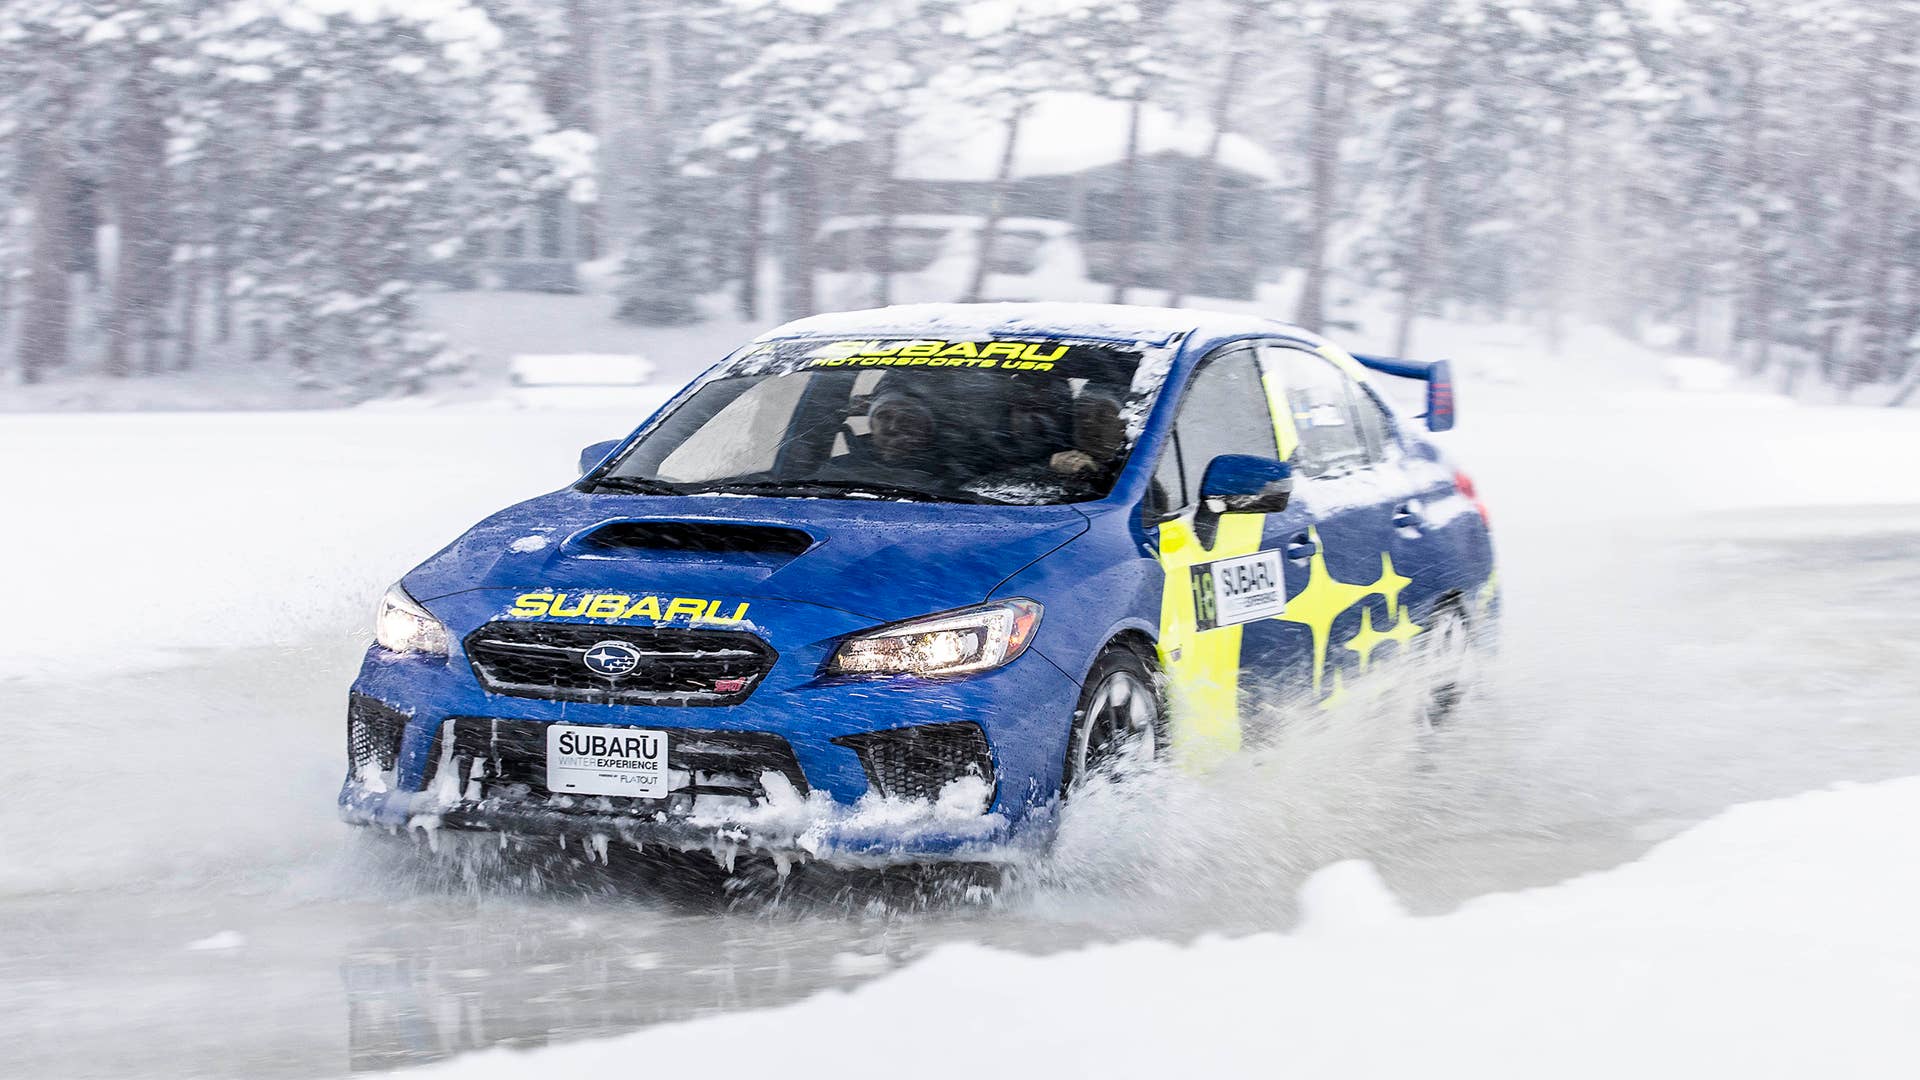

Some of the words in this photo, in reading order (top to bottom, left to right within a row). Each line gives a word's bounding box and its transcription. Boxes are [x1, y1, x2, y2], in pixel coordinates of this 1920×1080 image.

[818, 340, 1070, 361] SUBARU
[809, 357, 998, 368] MOTORSPORTS
[1000, 360, 1055, 371] USA
[510, 593, 750, 624] SUBARU
[559, 733, 658, 759] SUBARU
[560, 757, 596, 767] WINTER
[597, 758, 658, 770] EXPERIENCE
